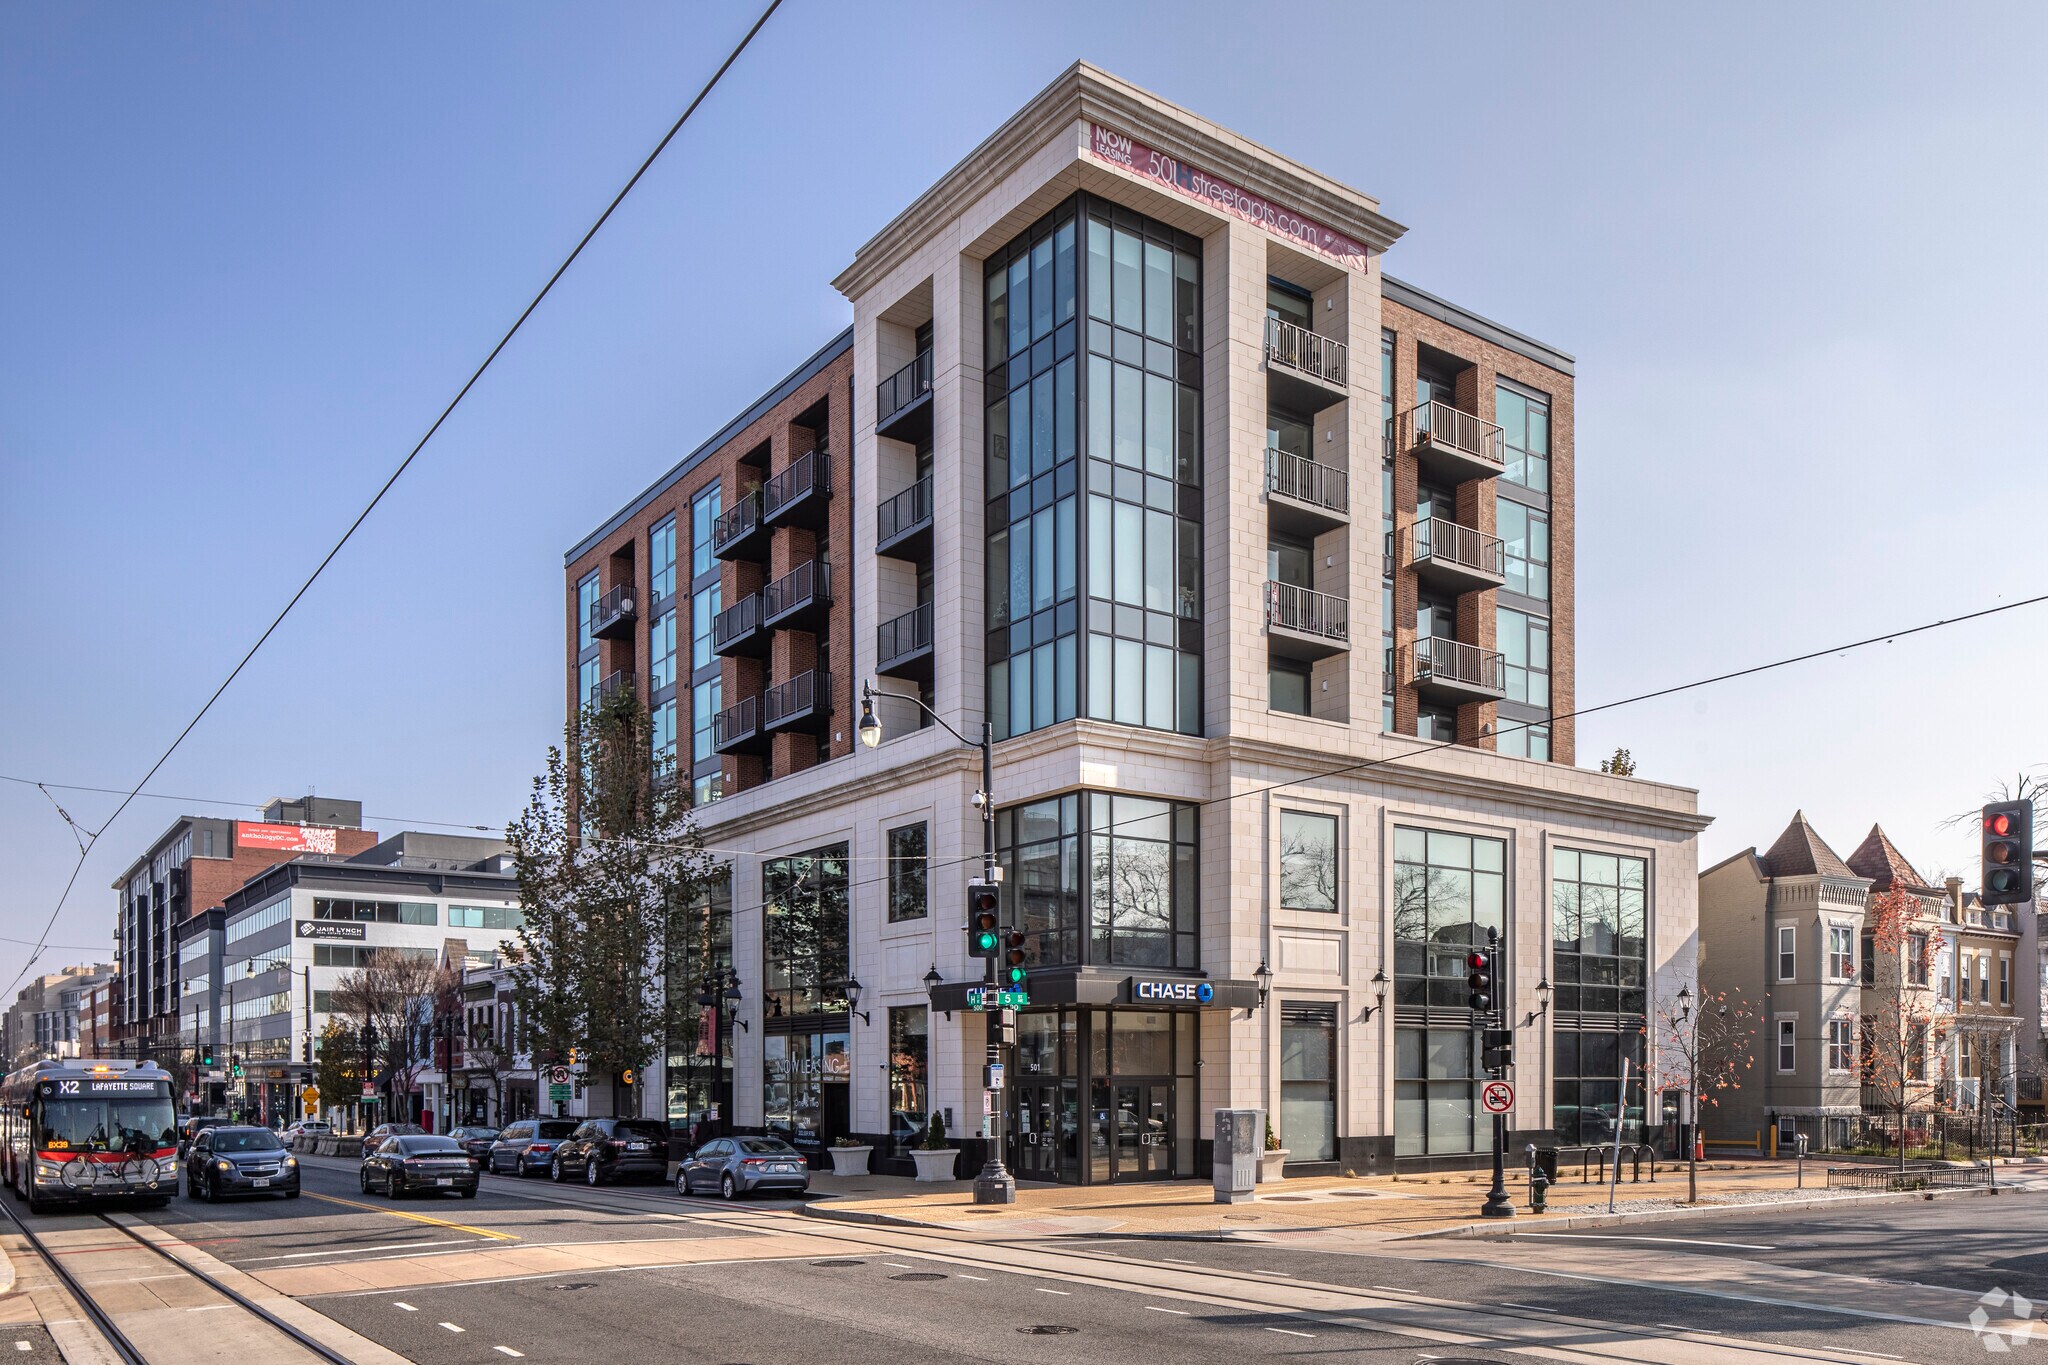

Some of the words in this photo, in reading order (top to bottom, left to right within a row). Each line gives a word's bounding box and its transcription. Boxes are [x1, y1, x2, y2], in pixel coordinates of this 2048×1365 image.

[1096, 125, 1132, 154] NOW
[1096, 142, 1132, 165] LEASING
[1004, 994, 1011, 1003] 5
[1138, 982, 1196, 1000] CHASE
[776, 1059, 799, 1074] NOW
[1030, 1063, 1040, 1071] 501
[59, 1080, 80, 1094] X2
[91, 1082, 128, 1091] LAFAYETTE
[129, 1082, 154, 1090] SQUARE
